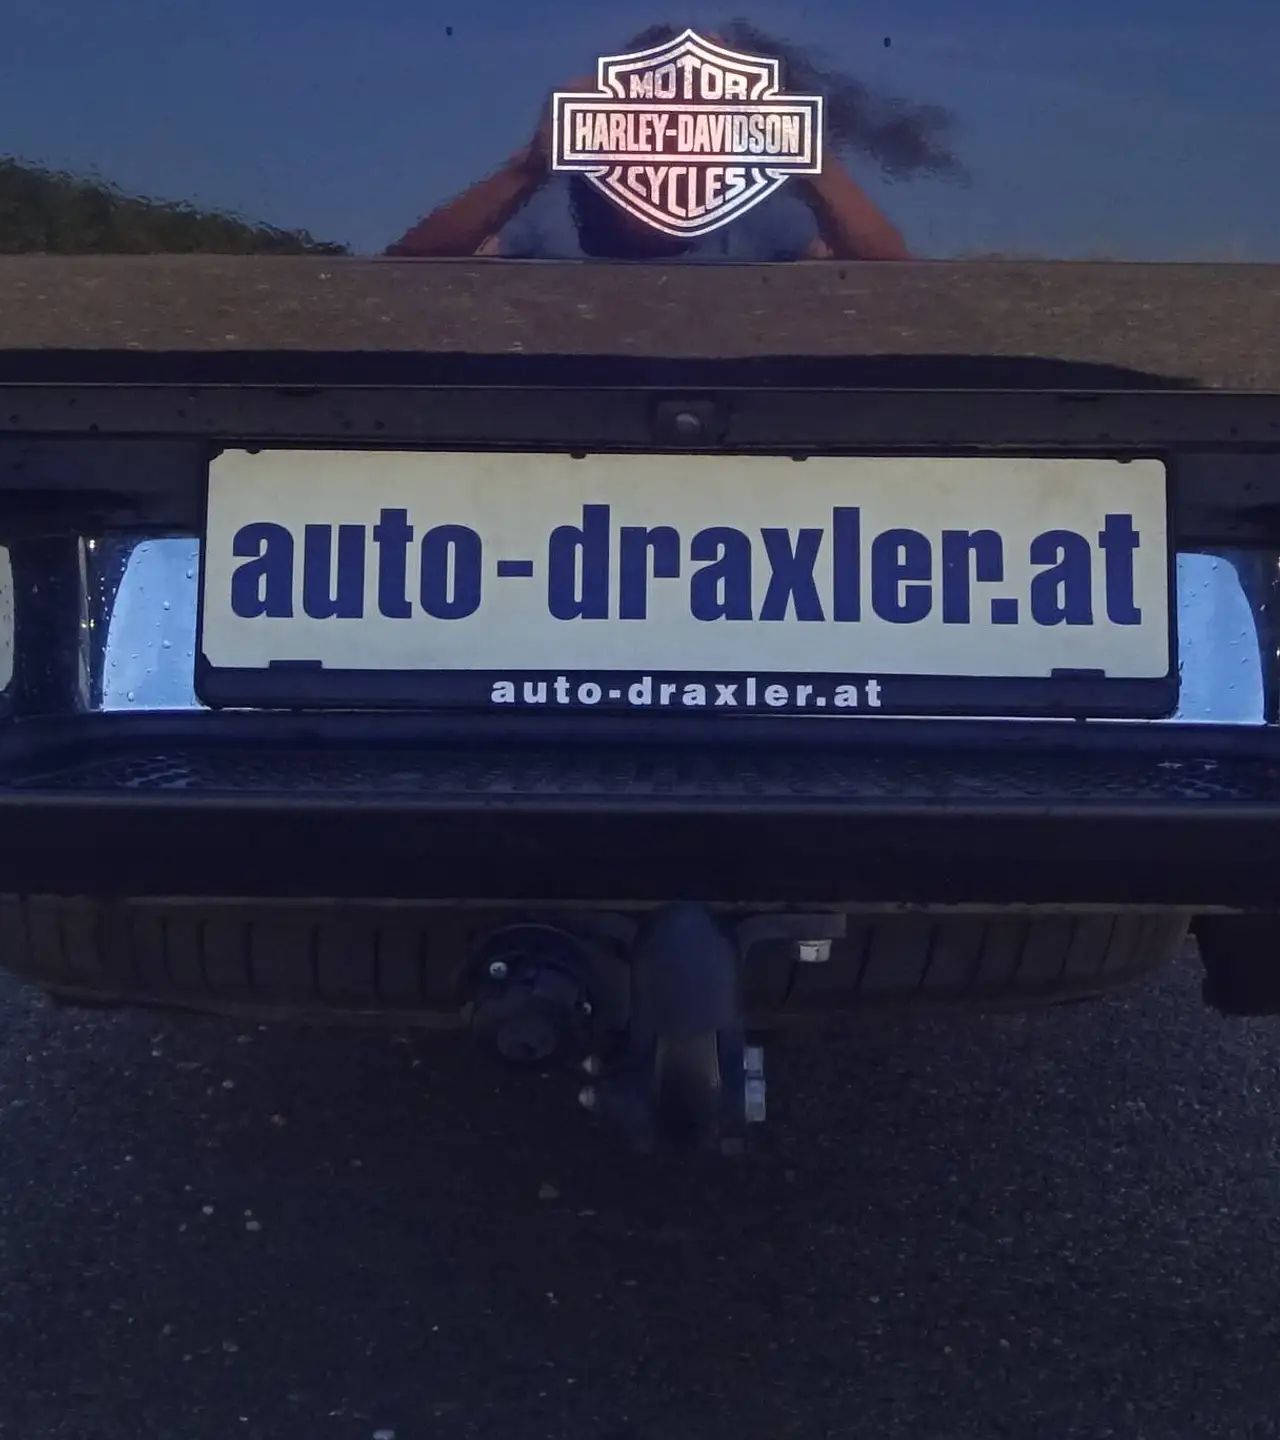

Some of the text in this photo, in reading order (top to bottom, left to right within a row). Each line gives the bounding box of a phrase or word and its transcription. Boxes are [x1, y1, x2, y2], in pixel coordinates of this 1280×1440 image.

[628, 54, 748, 101] MOTOR
[575, 112, 800, 154] HARLEY-DAVIDSON
[627, 166, 747, 219] CYCLES
[229, 503, 1142, 626] auto-draxler.at
[490, 675, 882, 709] auto-draxler.at
